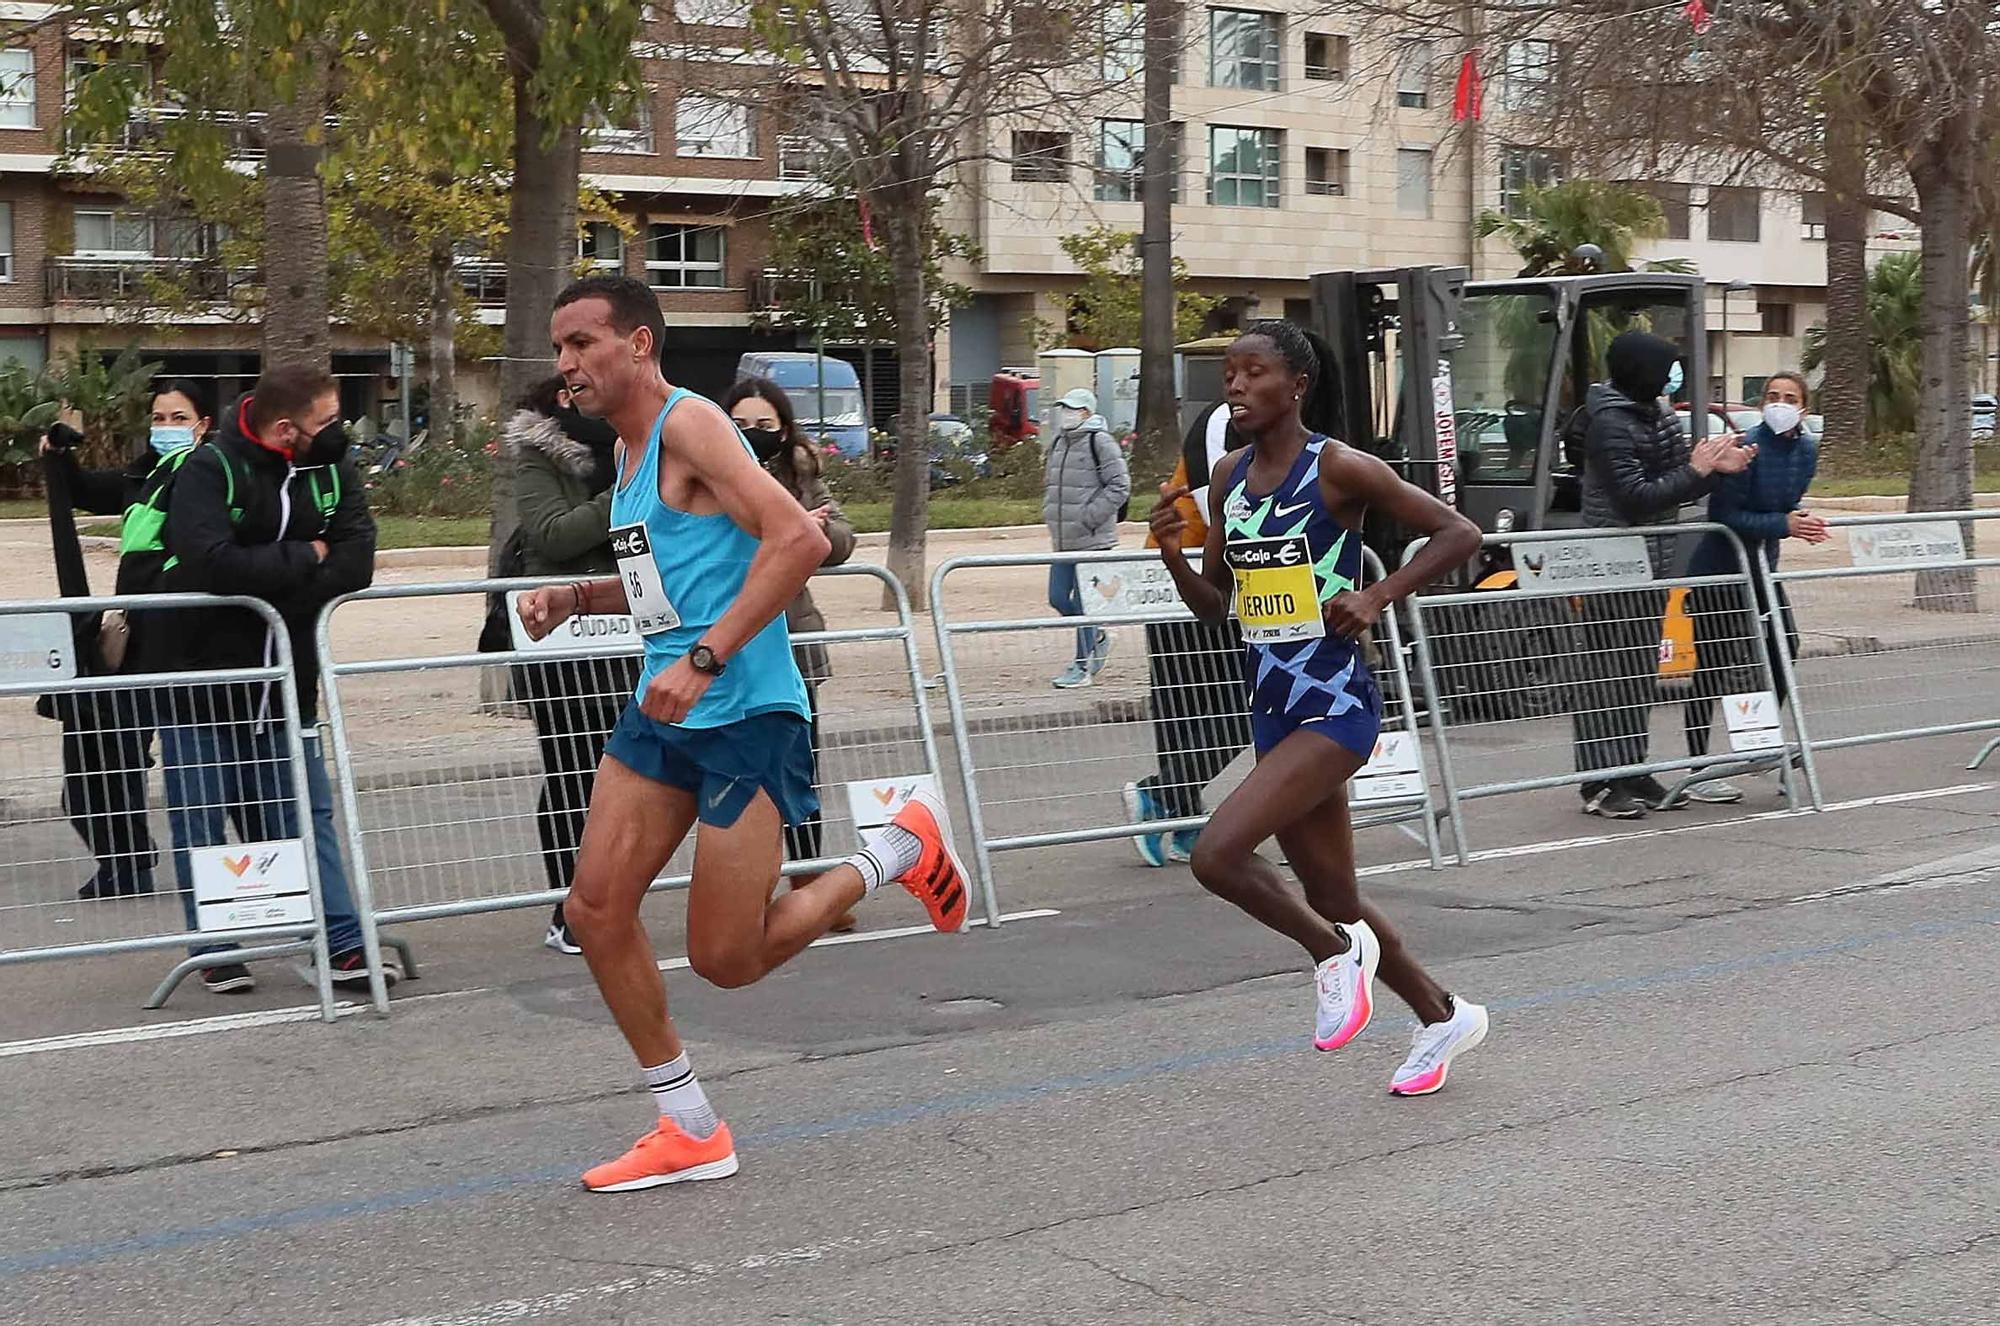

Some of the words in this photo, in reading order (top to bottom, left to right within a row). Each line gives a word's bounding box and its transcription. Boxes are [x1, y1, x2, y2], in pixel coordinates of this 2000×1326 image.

[628, 572, 643, 599] 56
[1243, 593, 1295, 616] JERUTO
[569, 617, 631, 638] CIUDAD
